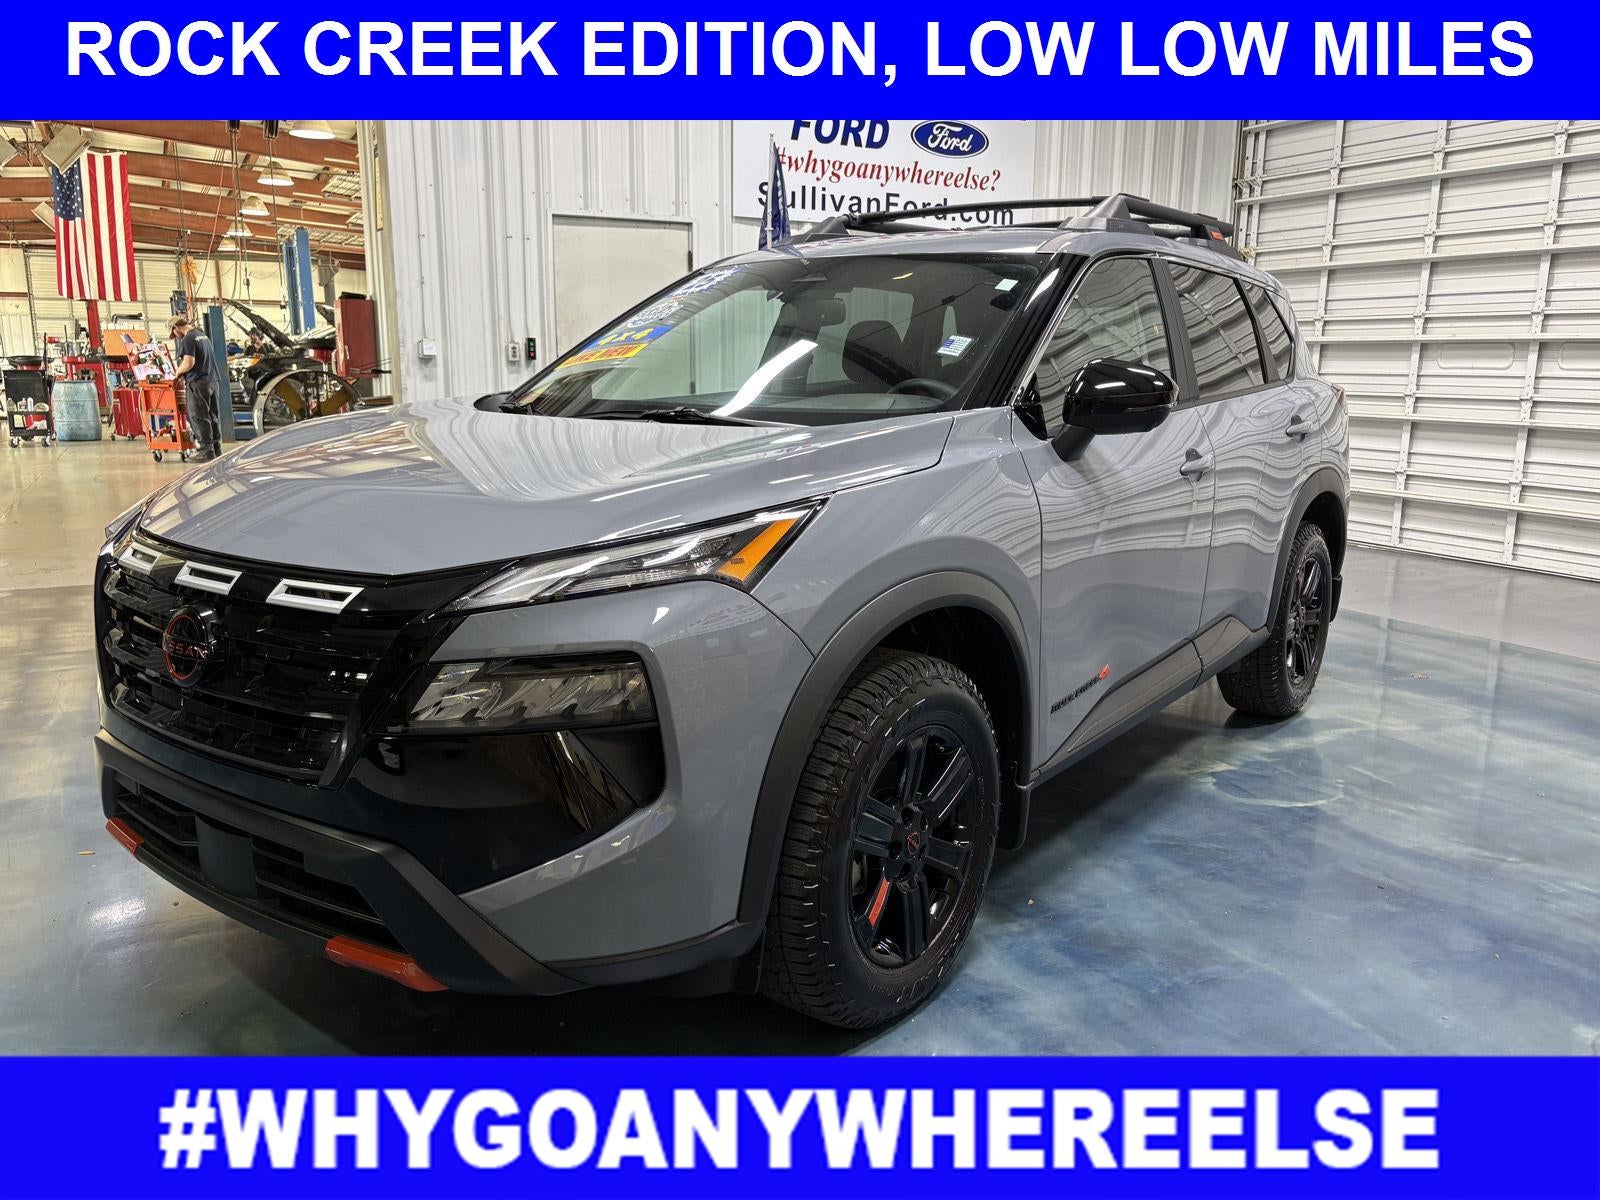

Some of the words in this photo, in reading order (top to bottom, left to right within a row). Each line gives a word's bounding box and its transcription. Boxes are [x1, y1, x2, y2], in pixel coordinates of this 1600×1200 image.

[790, 120, 890, 149] FORD
[926, 123, 974, 151] Ford
[778, 146, 1001, 191] #whygoanywhereelse?
